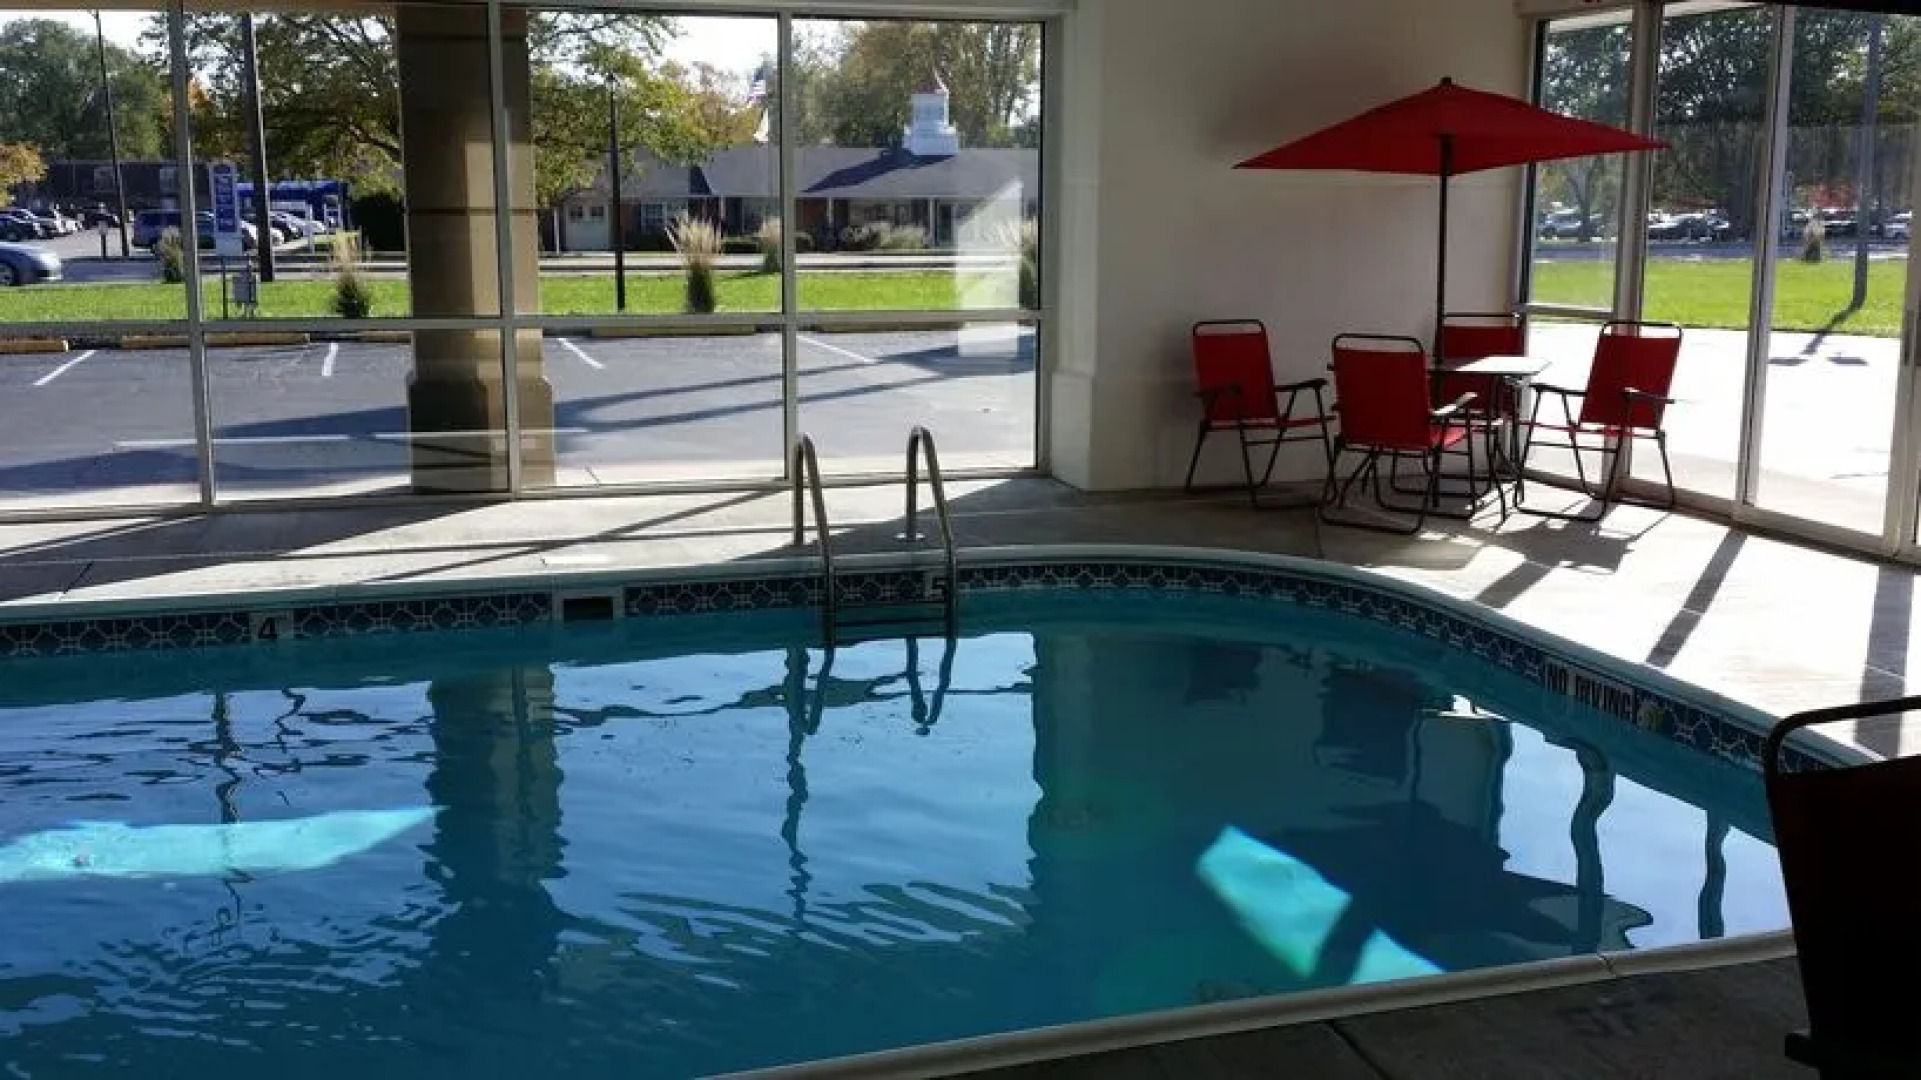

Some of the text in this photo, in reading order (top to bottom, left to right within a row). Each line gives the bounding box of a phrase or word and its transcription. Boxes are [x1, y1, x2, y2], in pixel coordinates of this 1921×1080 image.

[257, 616, 278, 640] 4
[1543, 662, 1634, 720] NO DIVING
